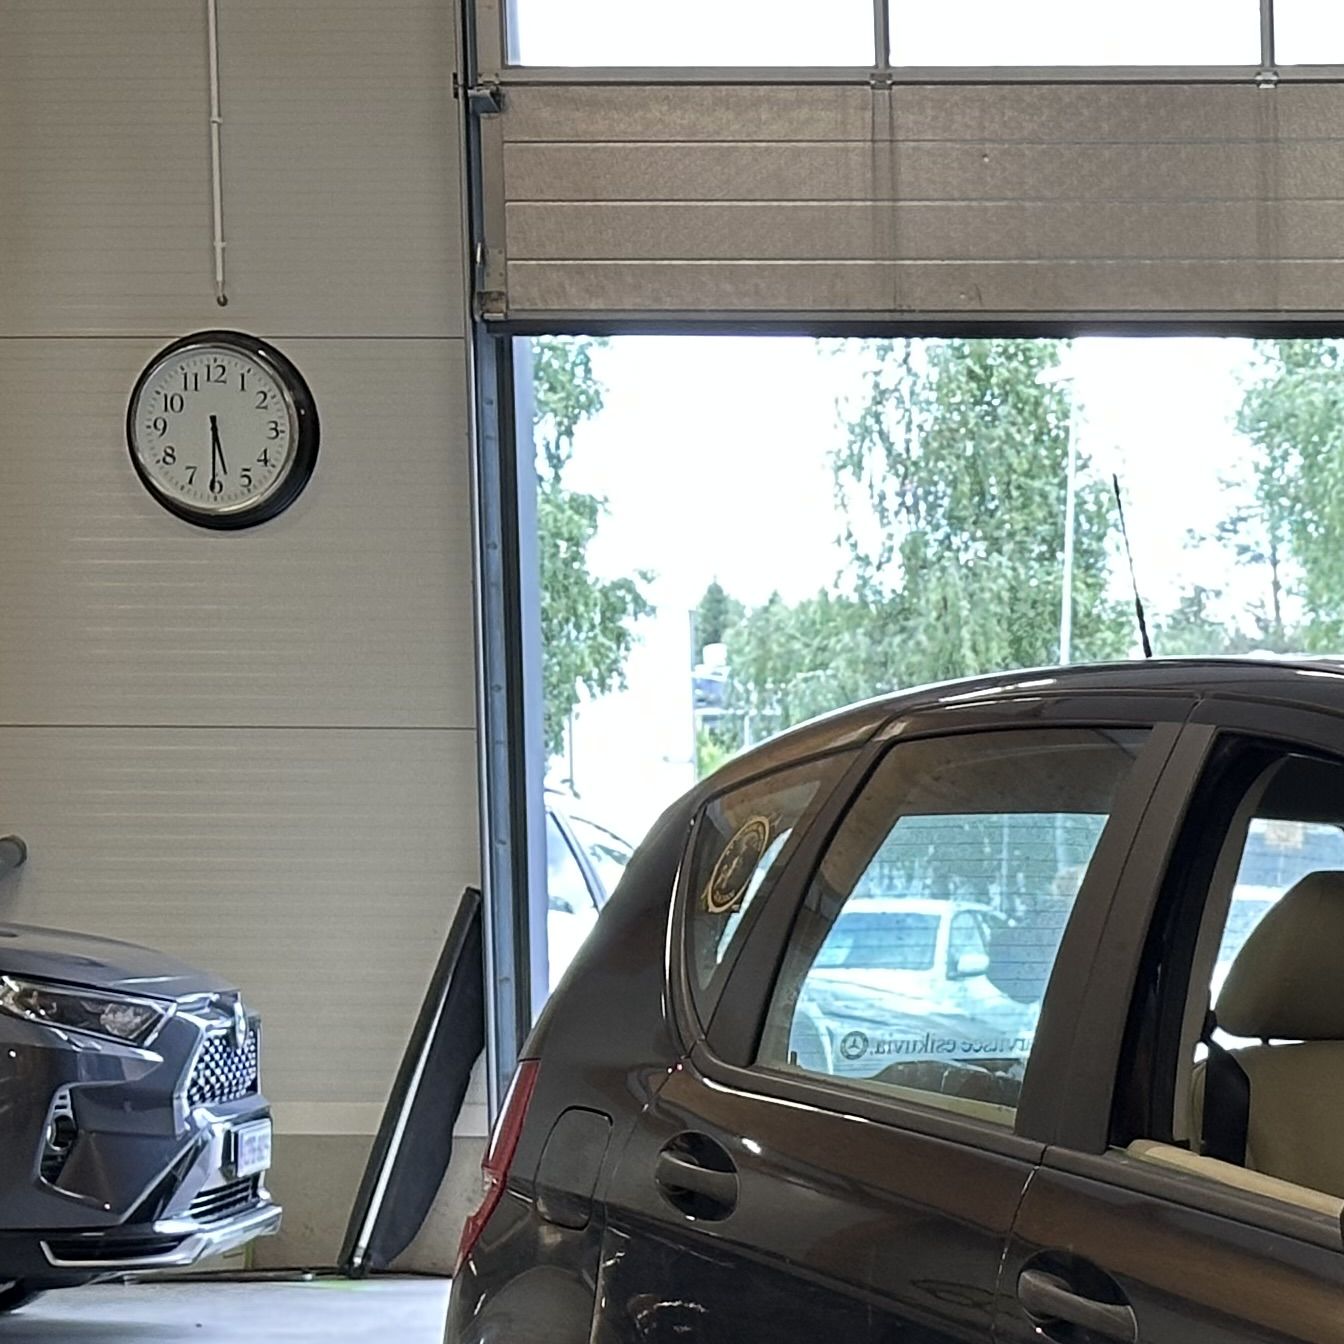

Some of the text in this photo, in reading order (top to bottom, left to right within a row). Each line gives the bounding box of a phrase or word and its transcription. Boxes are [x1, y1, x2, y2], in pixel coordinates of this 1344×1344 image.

[182, 371, 200, 392] 11
[205, 363, 227, 385] 12
[238, 372, 247, 392] 1
[163, 392, 184, 414] 10
[255, 390, 268, 410] 2
[153, 417, 168, 438] 9
[268, 420, 280, 440] 3
[162, 445, 177, 466] 8
[257, 447, 270, 467] 4
[185, 466, 198, 486] 7
[209, 472, 224, 495] 6
[239, 467, 252, 488] 5
